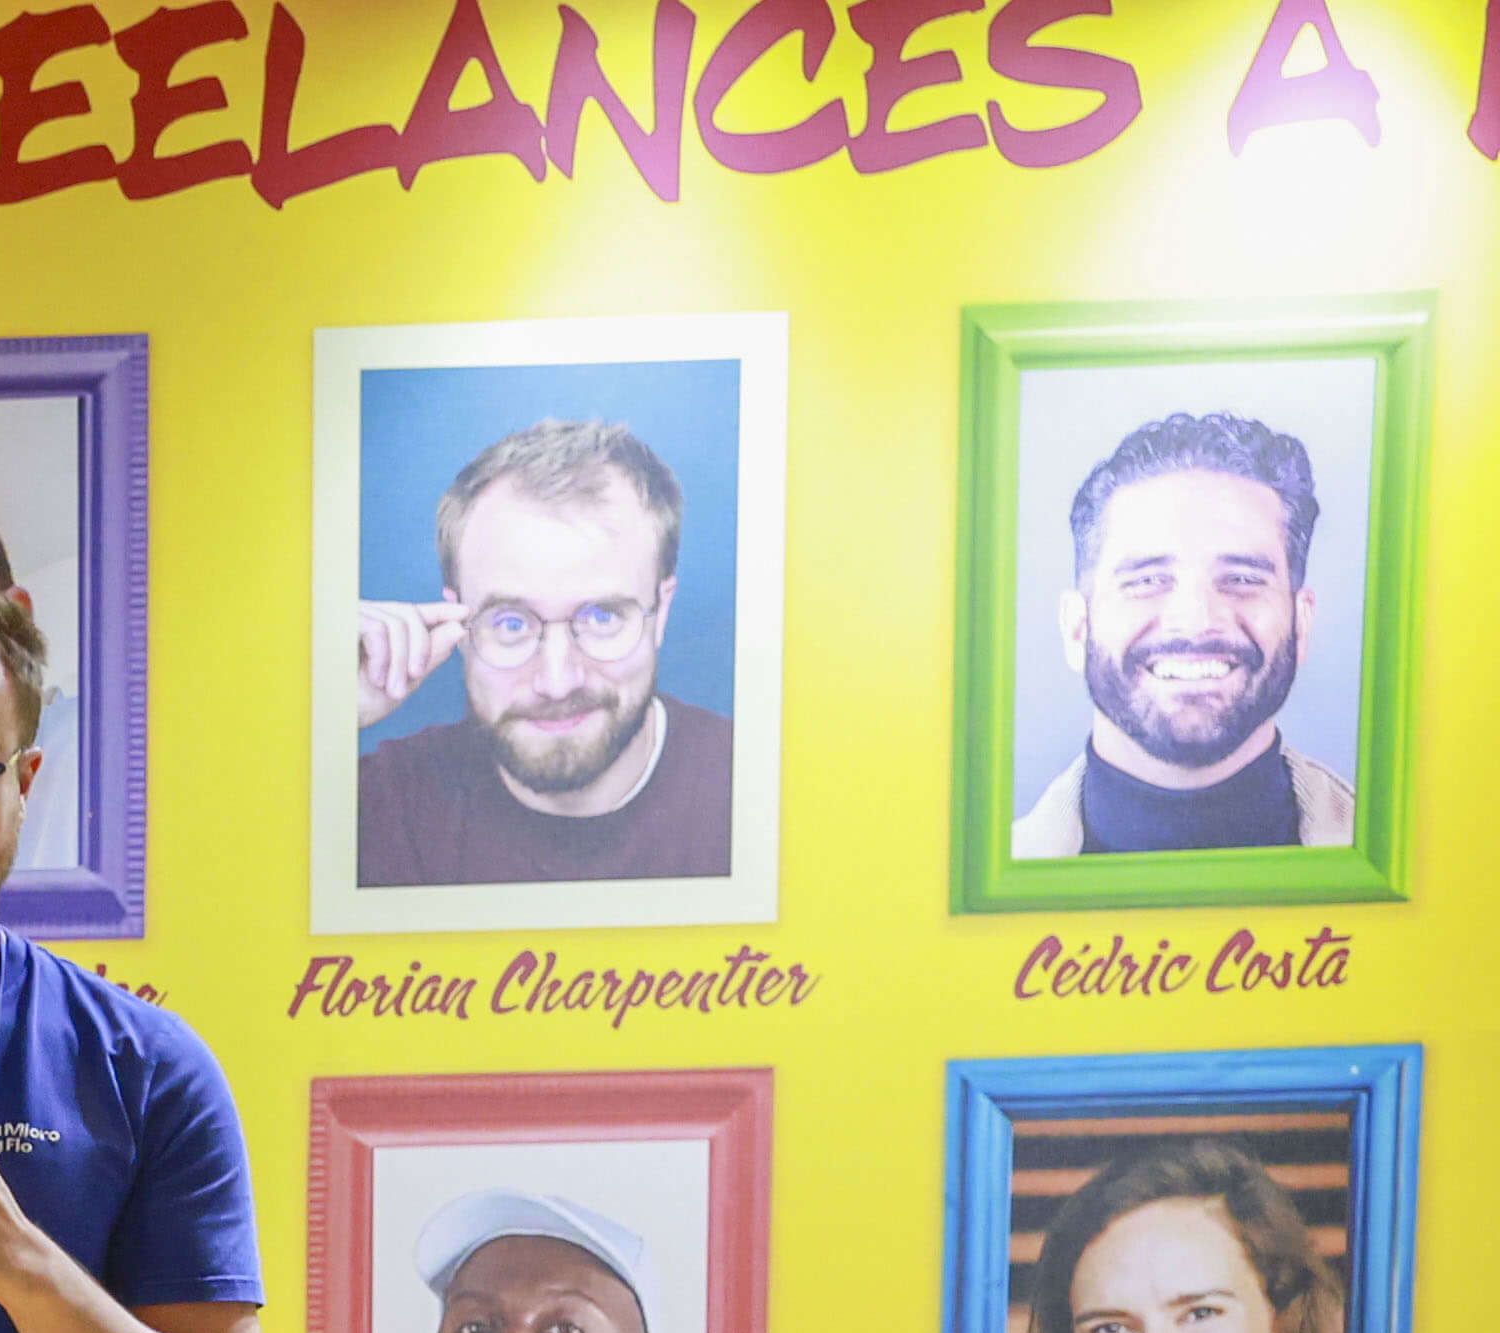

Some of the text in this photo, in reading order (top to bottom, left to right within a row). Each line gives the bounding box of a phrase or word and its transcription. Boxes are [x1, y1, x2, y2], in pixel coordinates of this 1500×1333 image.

[286, 944, 821, 1030] Florian Charpentier
[1013, 927, 1355, 1000] Cédric Costa
